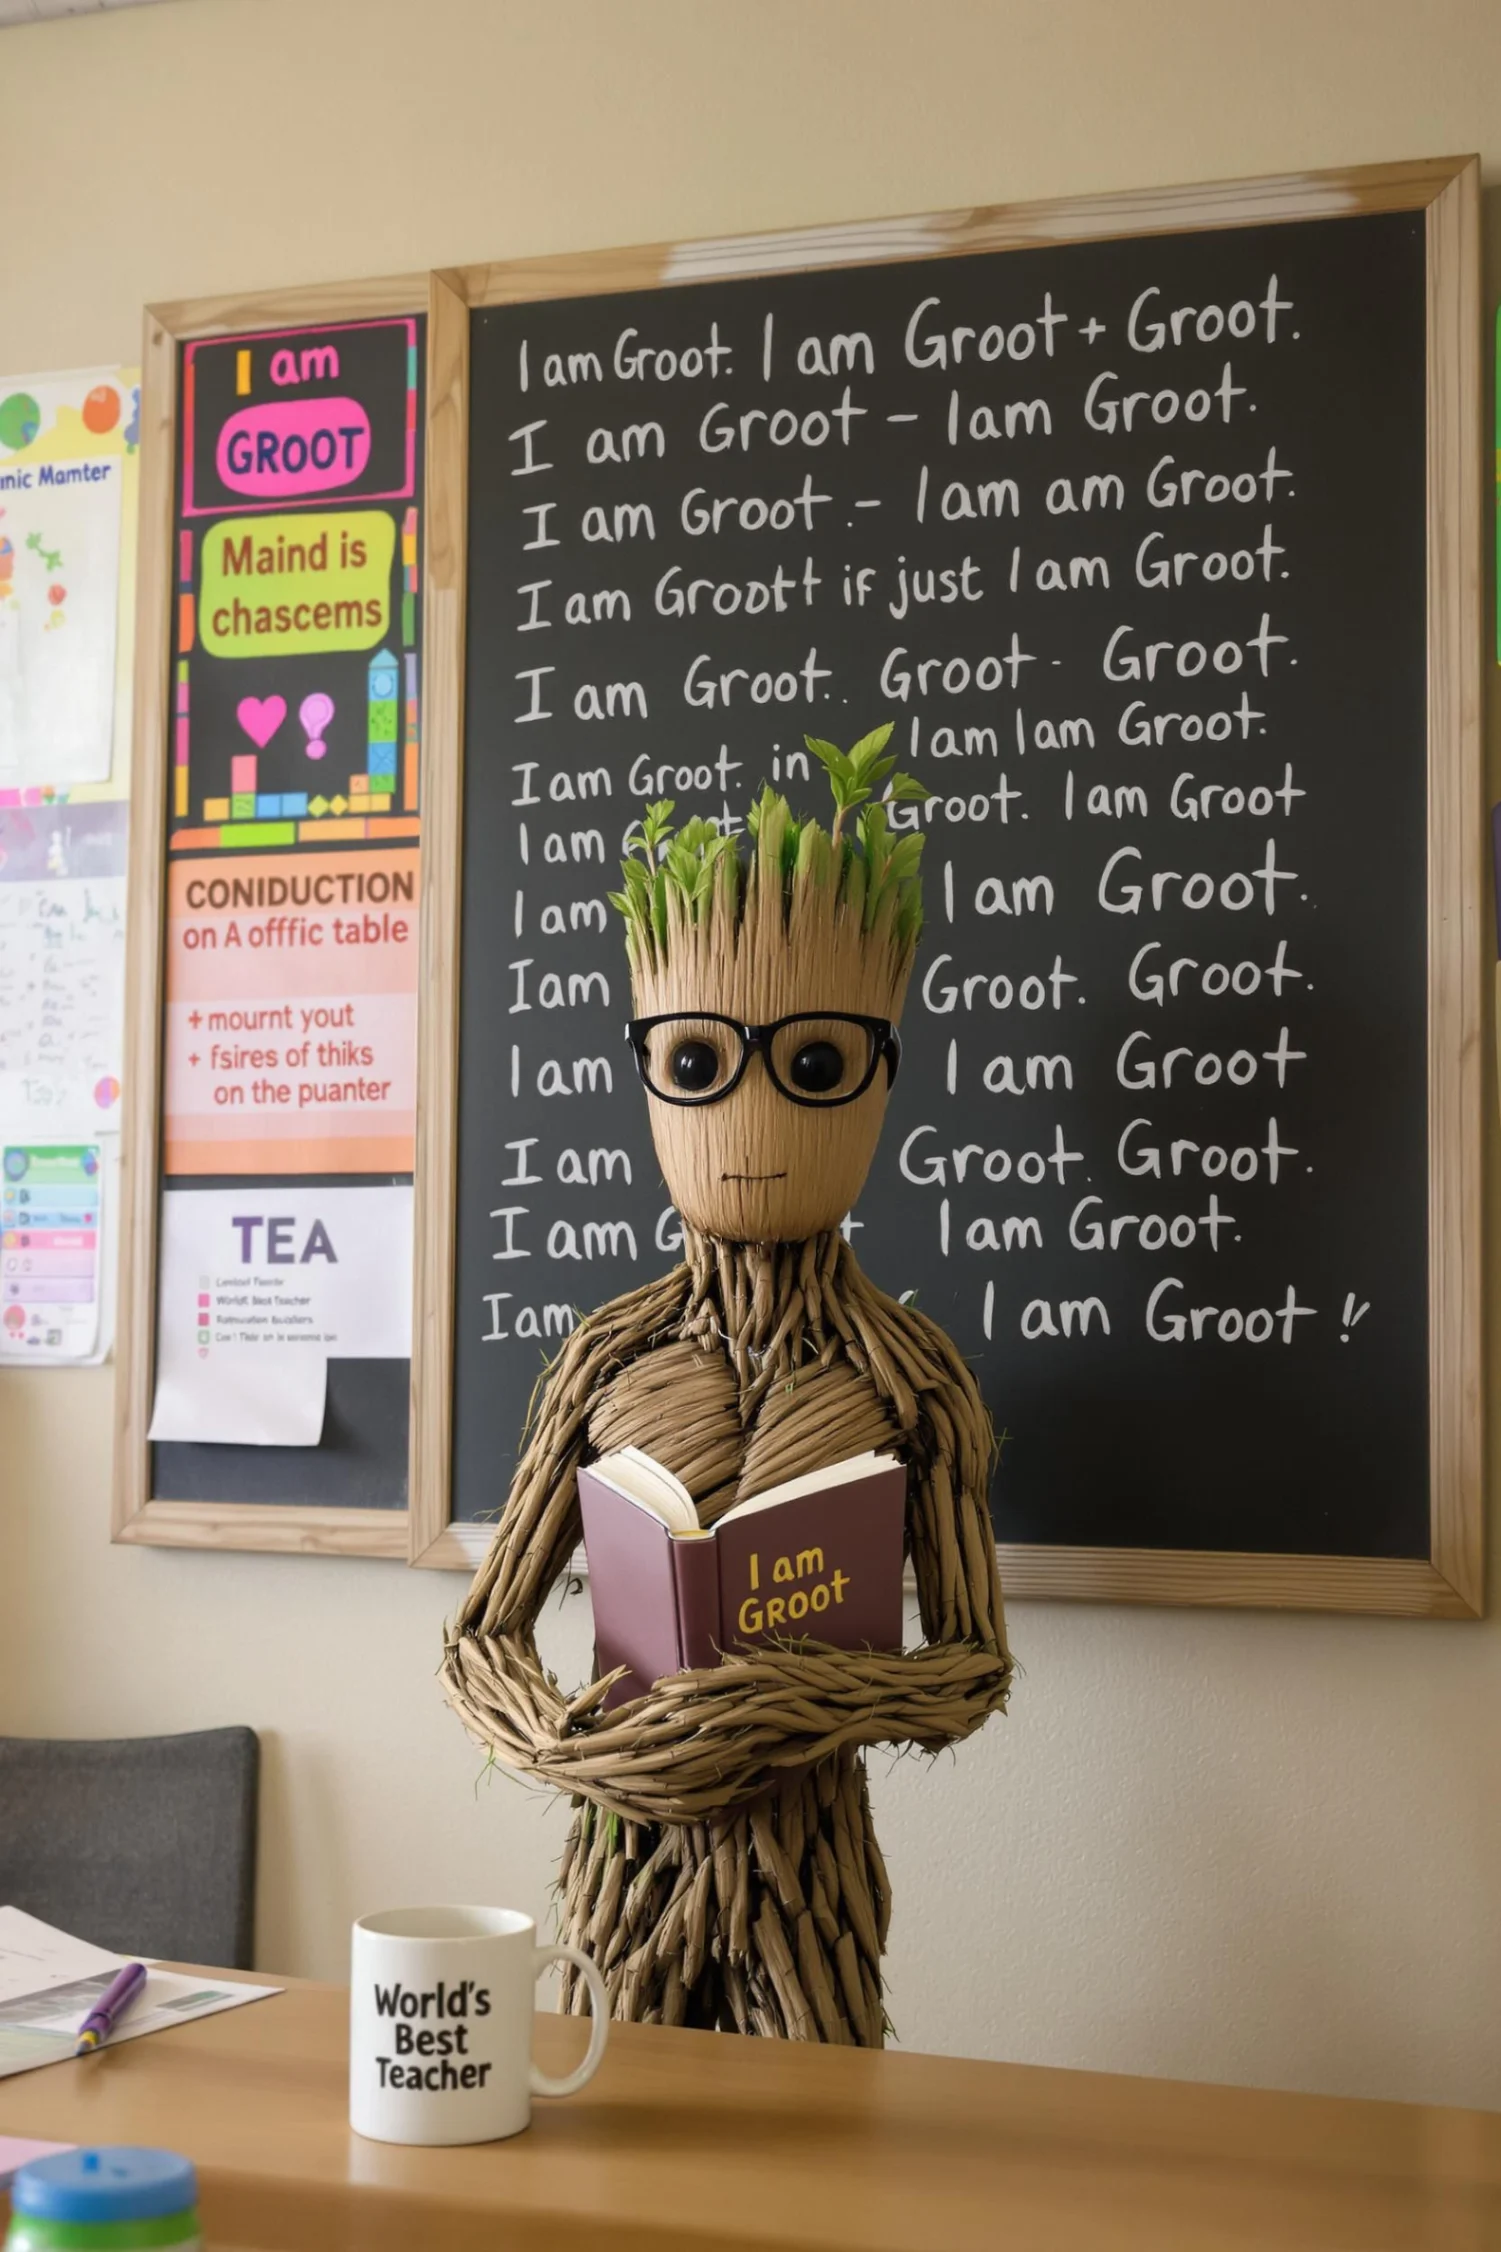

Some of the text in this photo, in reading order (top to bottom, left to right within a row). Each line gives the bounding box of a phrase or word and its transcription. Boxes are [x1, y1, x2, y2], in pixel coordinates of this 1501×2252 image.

[543, 352, 604, 387] am
[613, 321, 734, 382] Groot.
[763, 312, 774, 383] I
[797, 332, 875, 377] am
[904, 291, 1068, 370] Groot
[1127, 273, 1301, 353] Groot.
[236, 344, 339, 395] I am
[508, 419, 554, 476] I
[586, 421, 665, 464] am
[699, 385, 869, 453] Groot
[1084, 361, 1258, 435] Groot.
[522, 502, 561, 551] I
[581, 503, 656, 543] am
[681, 474, 834, 536] Groot
[1045, 474, 1125, 515] am
[1146, 446, 1296, 508] Groot.
[222, 532, 367, 577] Maind is
[889, 555, 985, 620] just
[1036, 556, 1110, 591] am
[1135, 523, 1290, 589] Groot.
[212, 598, 382, 636] chascems
[513, 666, 556, 724] I
[573, 681, 648, 721] am
[880, 631, 1038, 703] Groot
[1103, 612, 1299, 682] Groot.
[1118, 691, 1267, 747] Groot.
[628, 744, 743, 796] Groot.
[1087, 784, 1148, 819] am
[1170, 762, 1307, 822] Groot
[543, 828, 606, 864] am
[186, 871, 414, 909] CONIDUCTION
[944, 838, 1309, 924] I am Groot.
[183, 926, 216, 949] on
[224, 922, 242, 948] A
[333, 913, 408, 945] table
[540, 898, 608, 935] am
[922, 940, 1315, 1015] Groot. Groot.
[208, 1005, 293, 1032] mournt
[300, 1002, 355, 1034] yout
[285, 1041, 311, 1068] of
[318, 1040, 374, 1067] thiks
[536, 1056, 613, 1097] am
[947, 1026, 1308, 1096] I am Groot
[214, 1076, 391, 1108] on the puanter
[1116, 1117, 1314, 1184] Groot.
[232, 1216, 339, 1264] TEA
[546, 1219, 638, 1261] am
[965, 1216, 1043, 1252] am
[1069, 1194, 1242, 1252] Groot.
[983, 1280, 995, 1341] I
[1020, 1296, 1111, 1340] am
[1146, 1277, 1317, 1344] Groot
[750, 1546, 824, 1591] I am
[375, 1980, 492, 2019] World's
[395, 2023, 468, 2057] Best
[376, 2056, 492, 2092] Teacher
